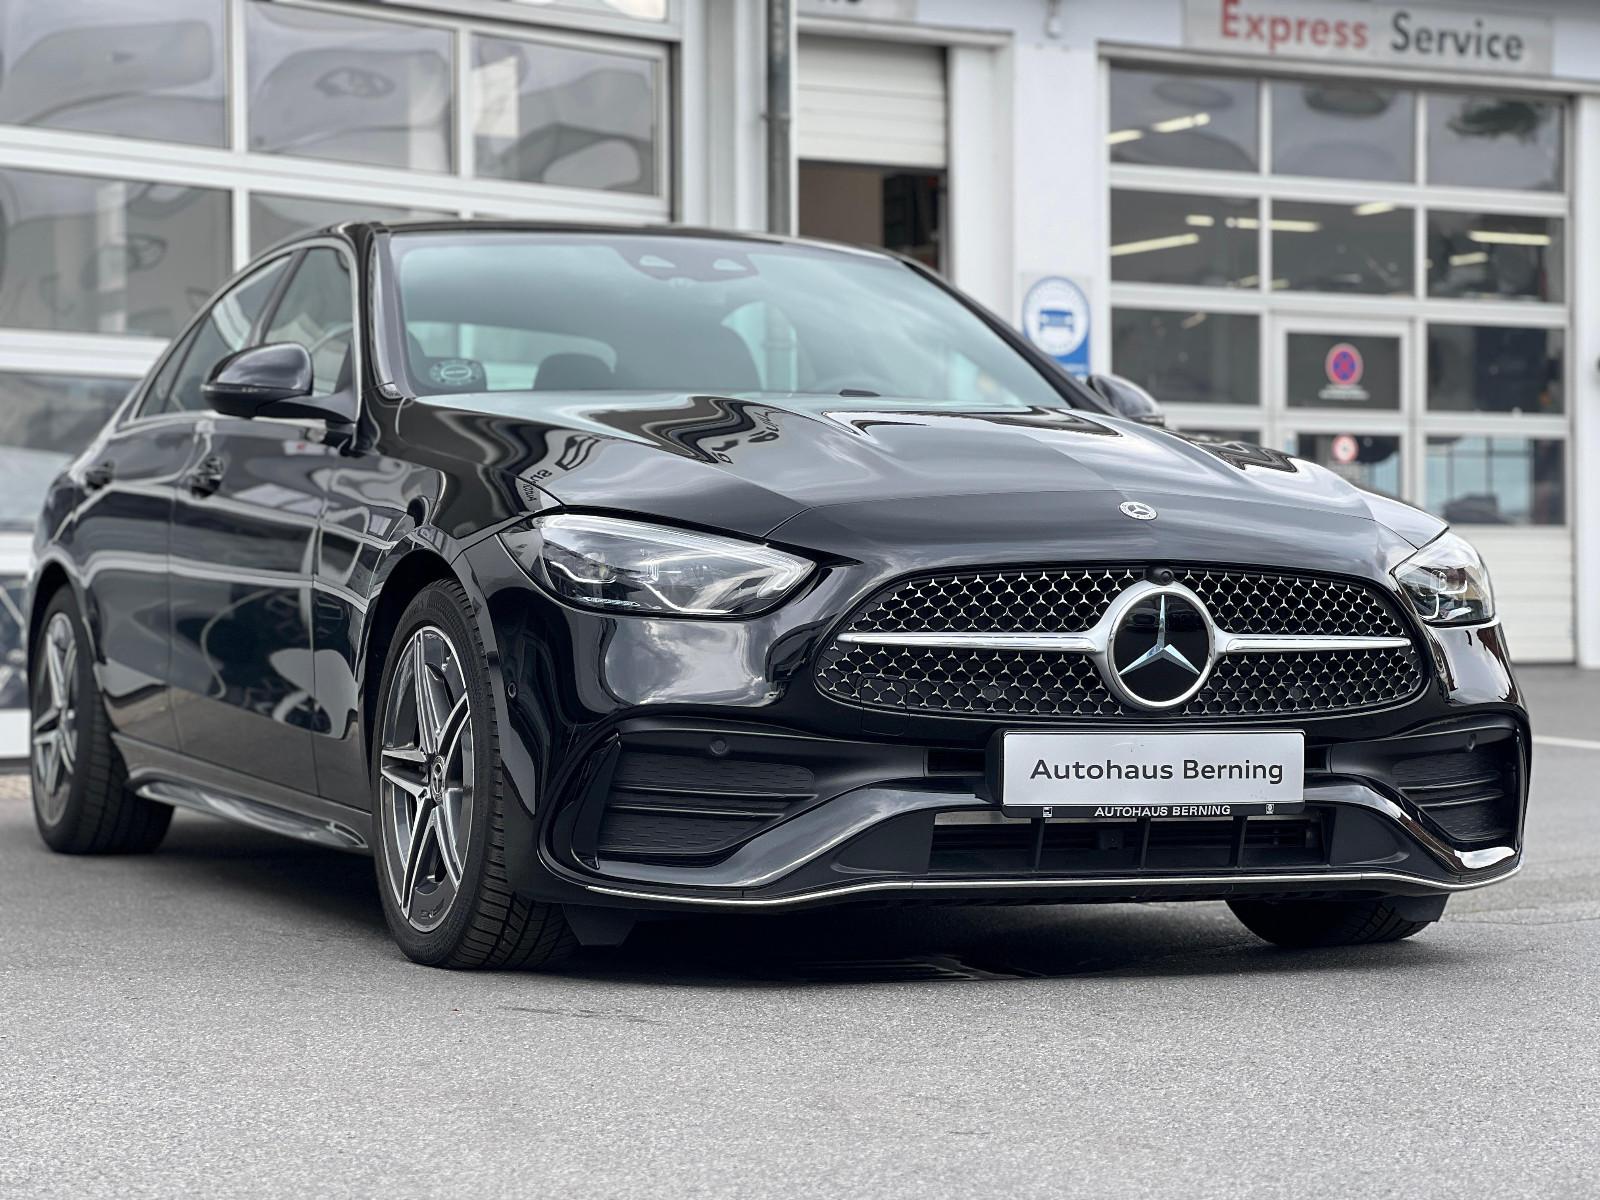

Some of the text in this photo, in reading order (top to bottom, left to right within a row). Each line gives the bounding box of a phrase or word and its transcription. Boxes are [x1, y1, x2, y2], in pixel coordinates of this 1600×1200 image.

[1220, 0, 1524, 61] Express Service
[1029, 758, 1284, 785] Autohaus Berning
[1094, 805, 1231, 818] AUTOHAUS BERNING
